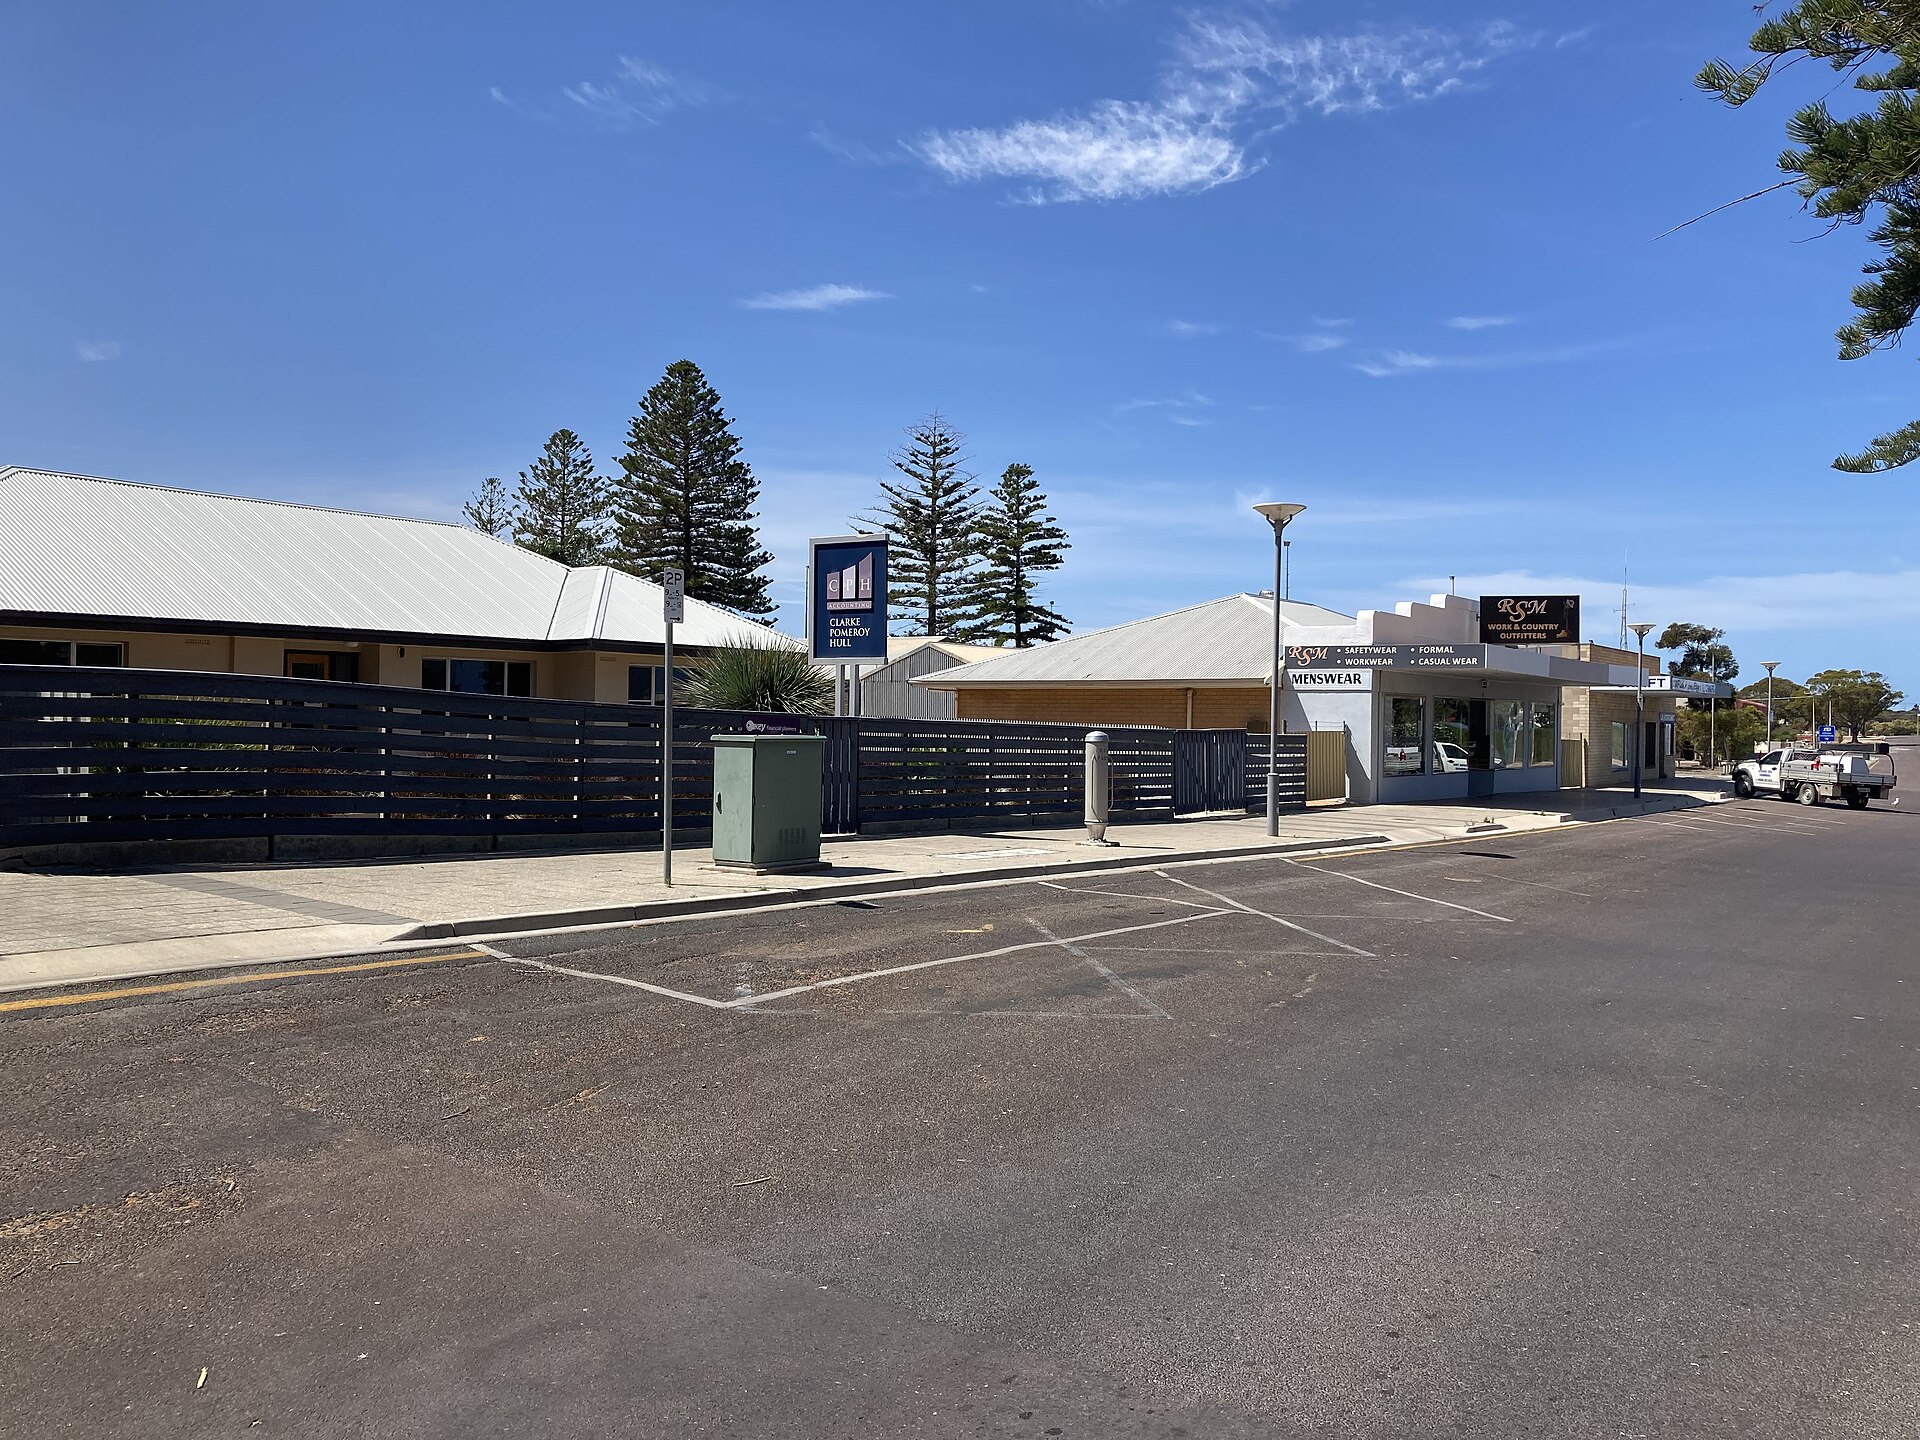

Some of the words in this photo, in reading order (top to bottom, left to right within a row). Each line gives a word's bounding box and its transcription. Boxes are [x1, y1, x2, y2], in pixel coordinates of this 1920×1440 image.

[666, 572, 682, 585] 2P
[1497, 598, 1548, 622] RSM
[829, 618, 861, 627] CLARKE
[829, 628, 871, 637] POMEROY
[829, 639, 852, 648] HULL
[1344, 646, 1397, 654] SAFETYWEAR
[1419, 646, 1455, 654] FORMAL
[1288, 645, 1329, 667] RSM
[1344, 658, 1394, 666] WORKWEAR
[1418, 657, 1451, 666] CASUAL
[1452, 657, 1478, 665] WEAR
[1291, 673, 1362, 685] MENSWEAR
